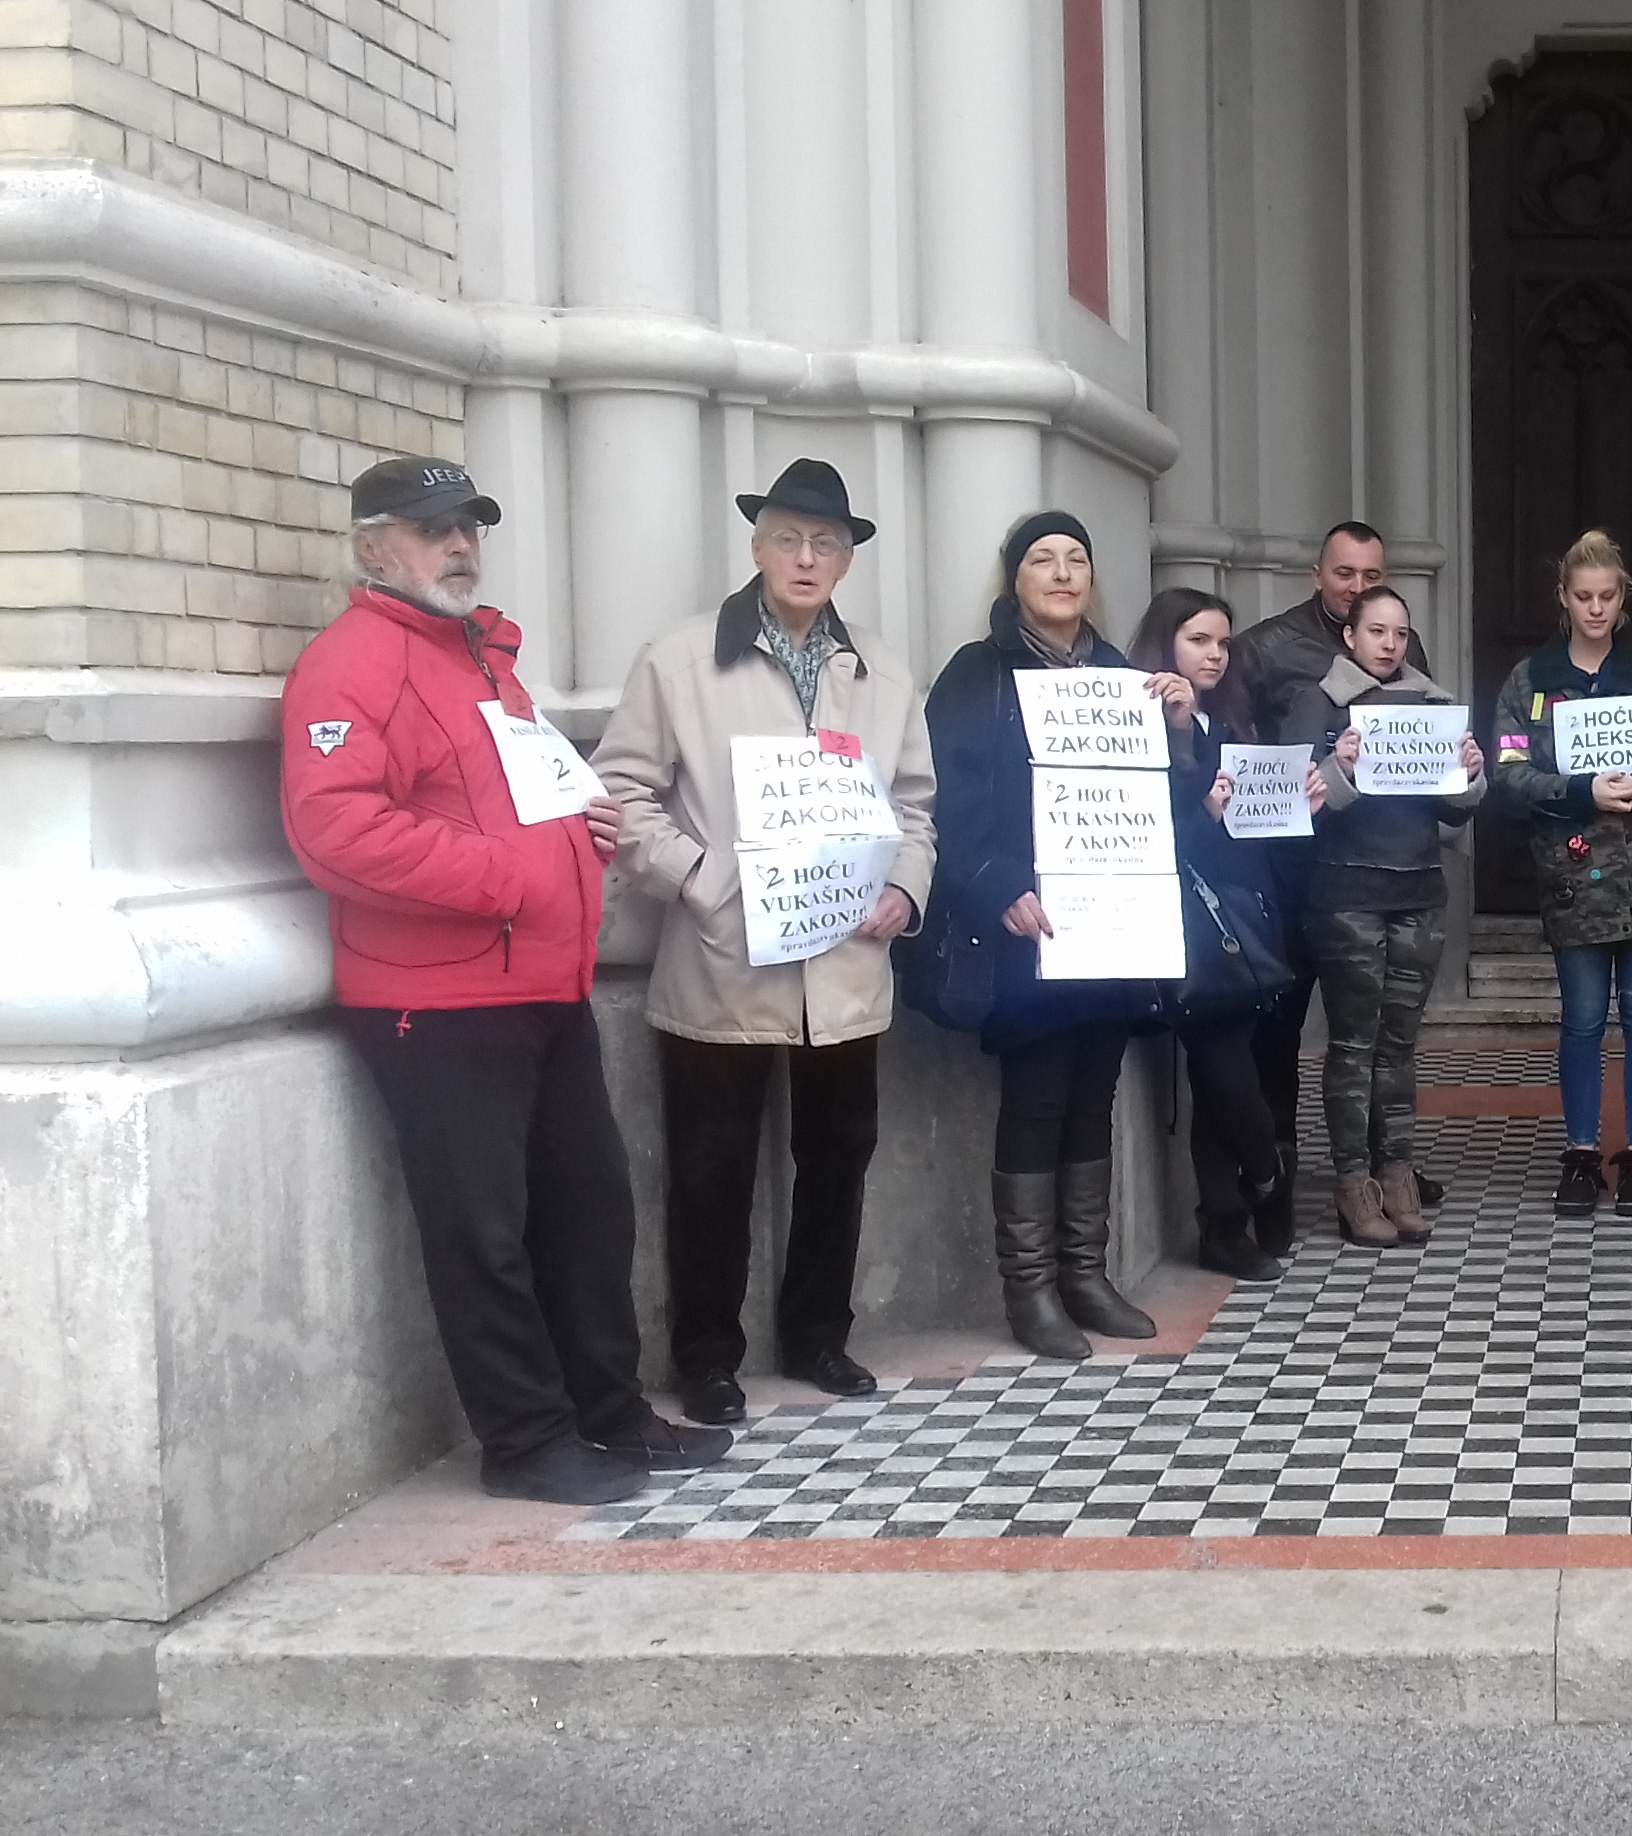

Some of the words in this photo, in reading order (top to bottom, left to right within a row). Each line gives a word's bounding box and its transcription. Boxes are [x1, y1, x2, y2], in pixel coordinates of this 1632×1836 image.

[1044, 708, 1144, 726] ALEKSIN
[1570, 716, 1579, 728] 2
[1369, 718, 1382, 736] 2
[1388, 718, 1434, 735] HOĆU
[836, 736, 849, 750] 2
[1045, 735, 1149, 754] ZAKON!!!
[1363, 739, 1457, 755] VUKAŠINOV
[554, 758, 570, 780] 2
[1237, 758, 1249, 776] 2
[1373, 761, 1445, 775] ZAKON!!!
[761, 778, 876, 800] ALEKSIN
[1054, 784, 1069, 803] 2
[1235, 802, 1292, 817] ZAKON!!!
[1064, 835, 1149, 850] ZAKON!!!
[766, 867, 785, 889] 2
[793, 859, 855, 885] HOĆU
[780, 905, 868, 938] ZAKON!!!
